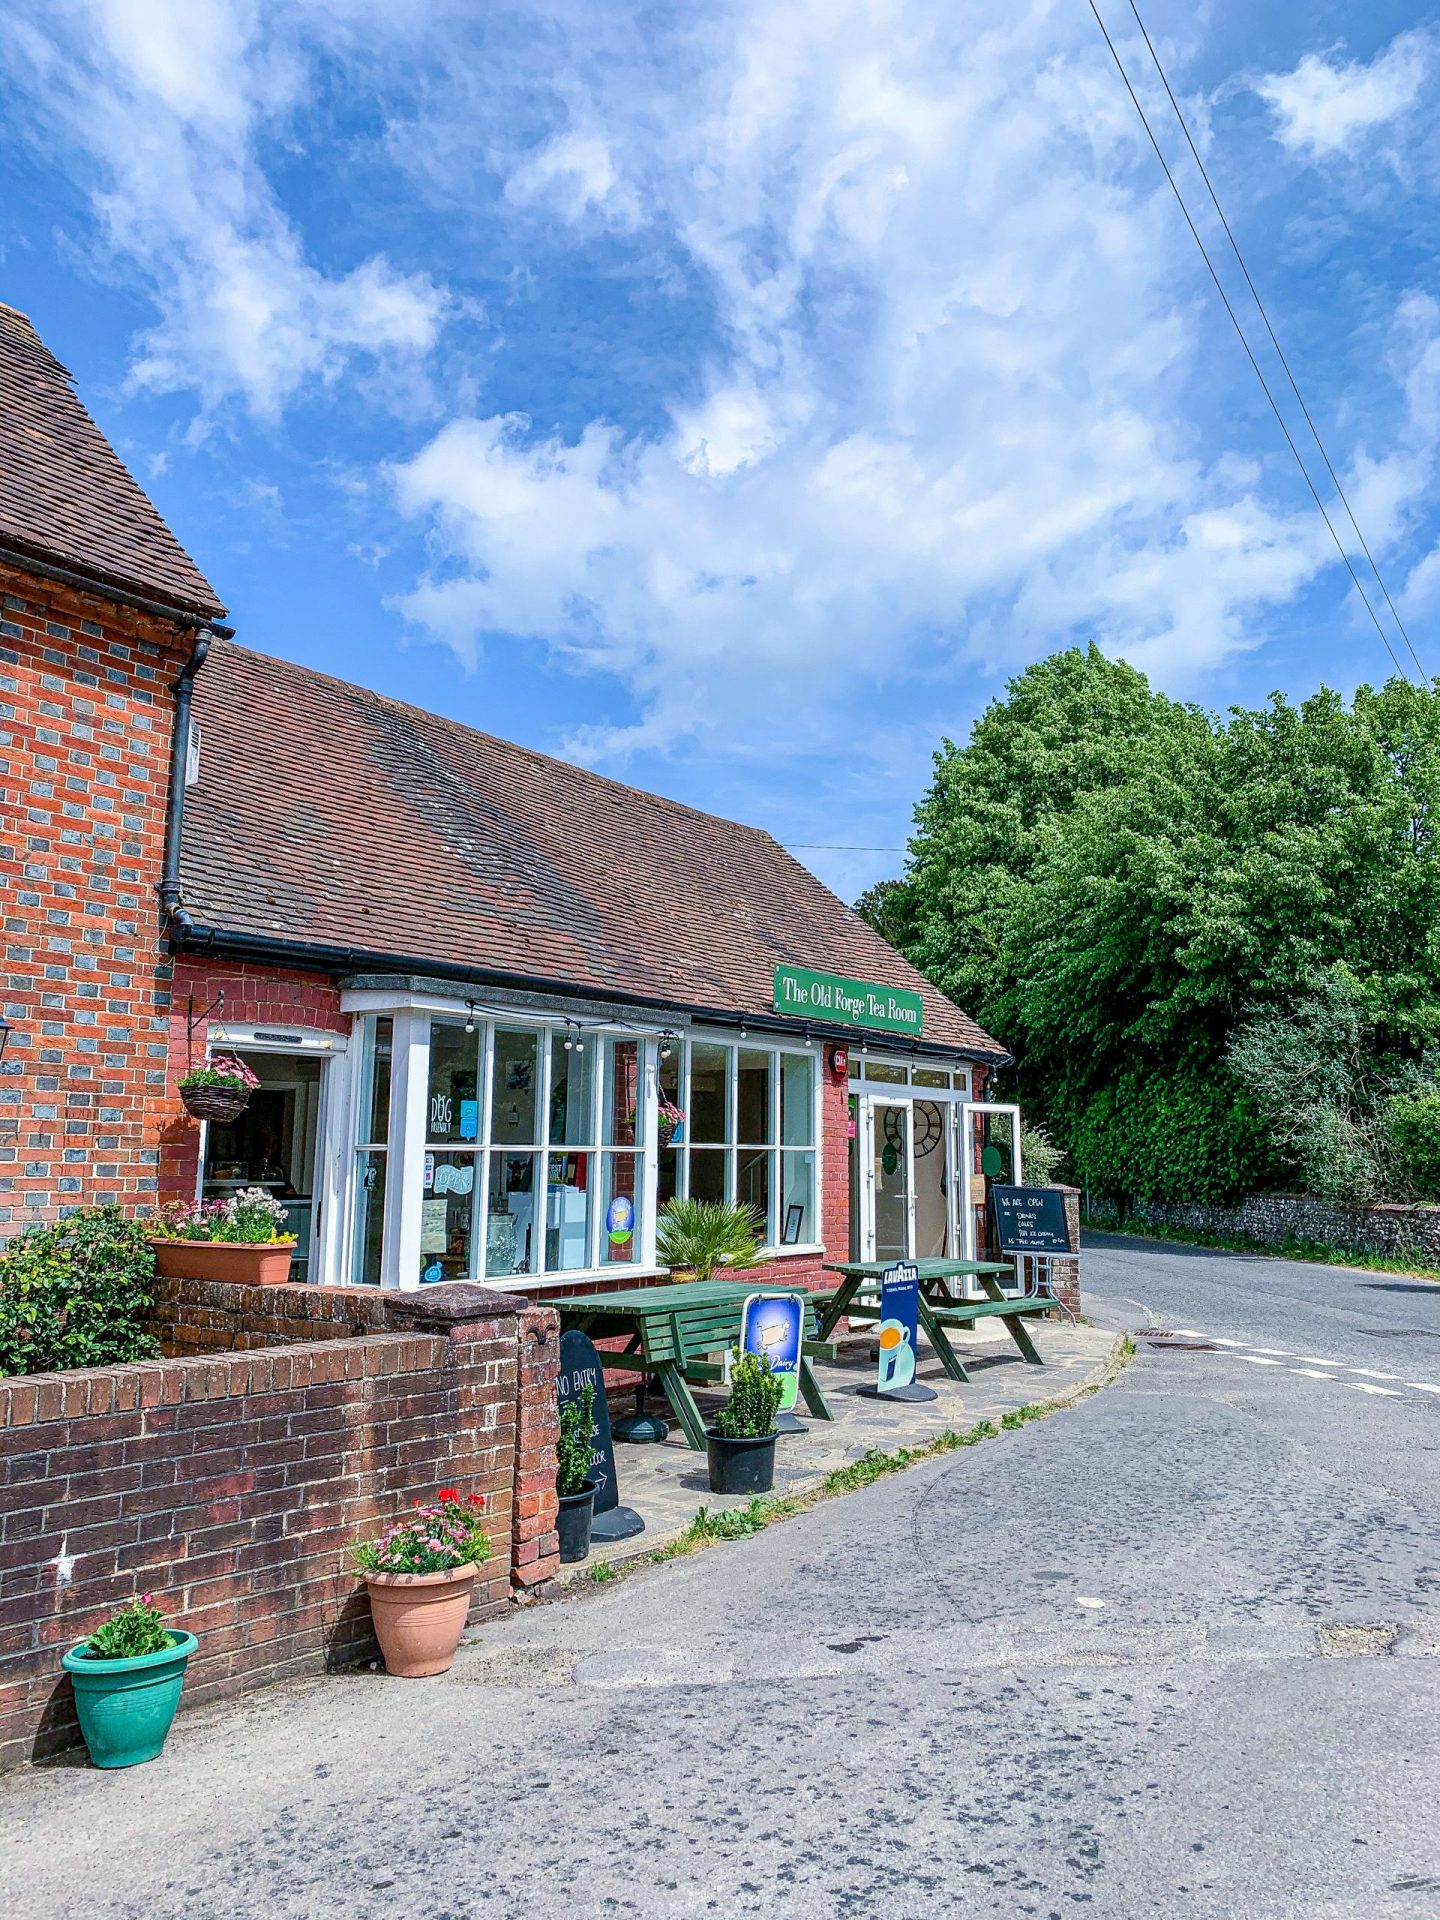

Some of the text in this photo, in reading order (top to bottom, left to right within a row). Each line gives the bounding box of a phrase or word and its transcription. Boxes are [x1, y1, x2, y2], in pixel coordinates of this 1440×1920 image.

[782, 976, 917, 1023] The Old Forge Tea Room
[431, 1093, 452, 1122] DOG
[883, 1264, 917, 1285] LAVAZZA
[769, 1354, 794, 1371] Dairy
[555, 1367, 597, 1397] NO ENTRY
